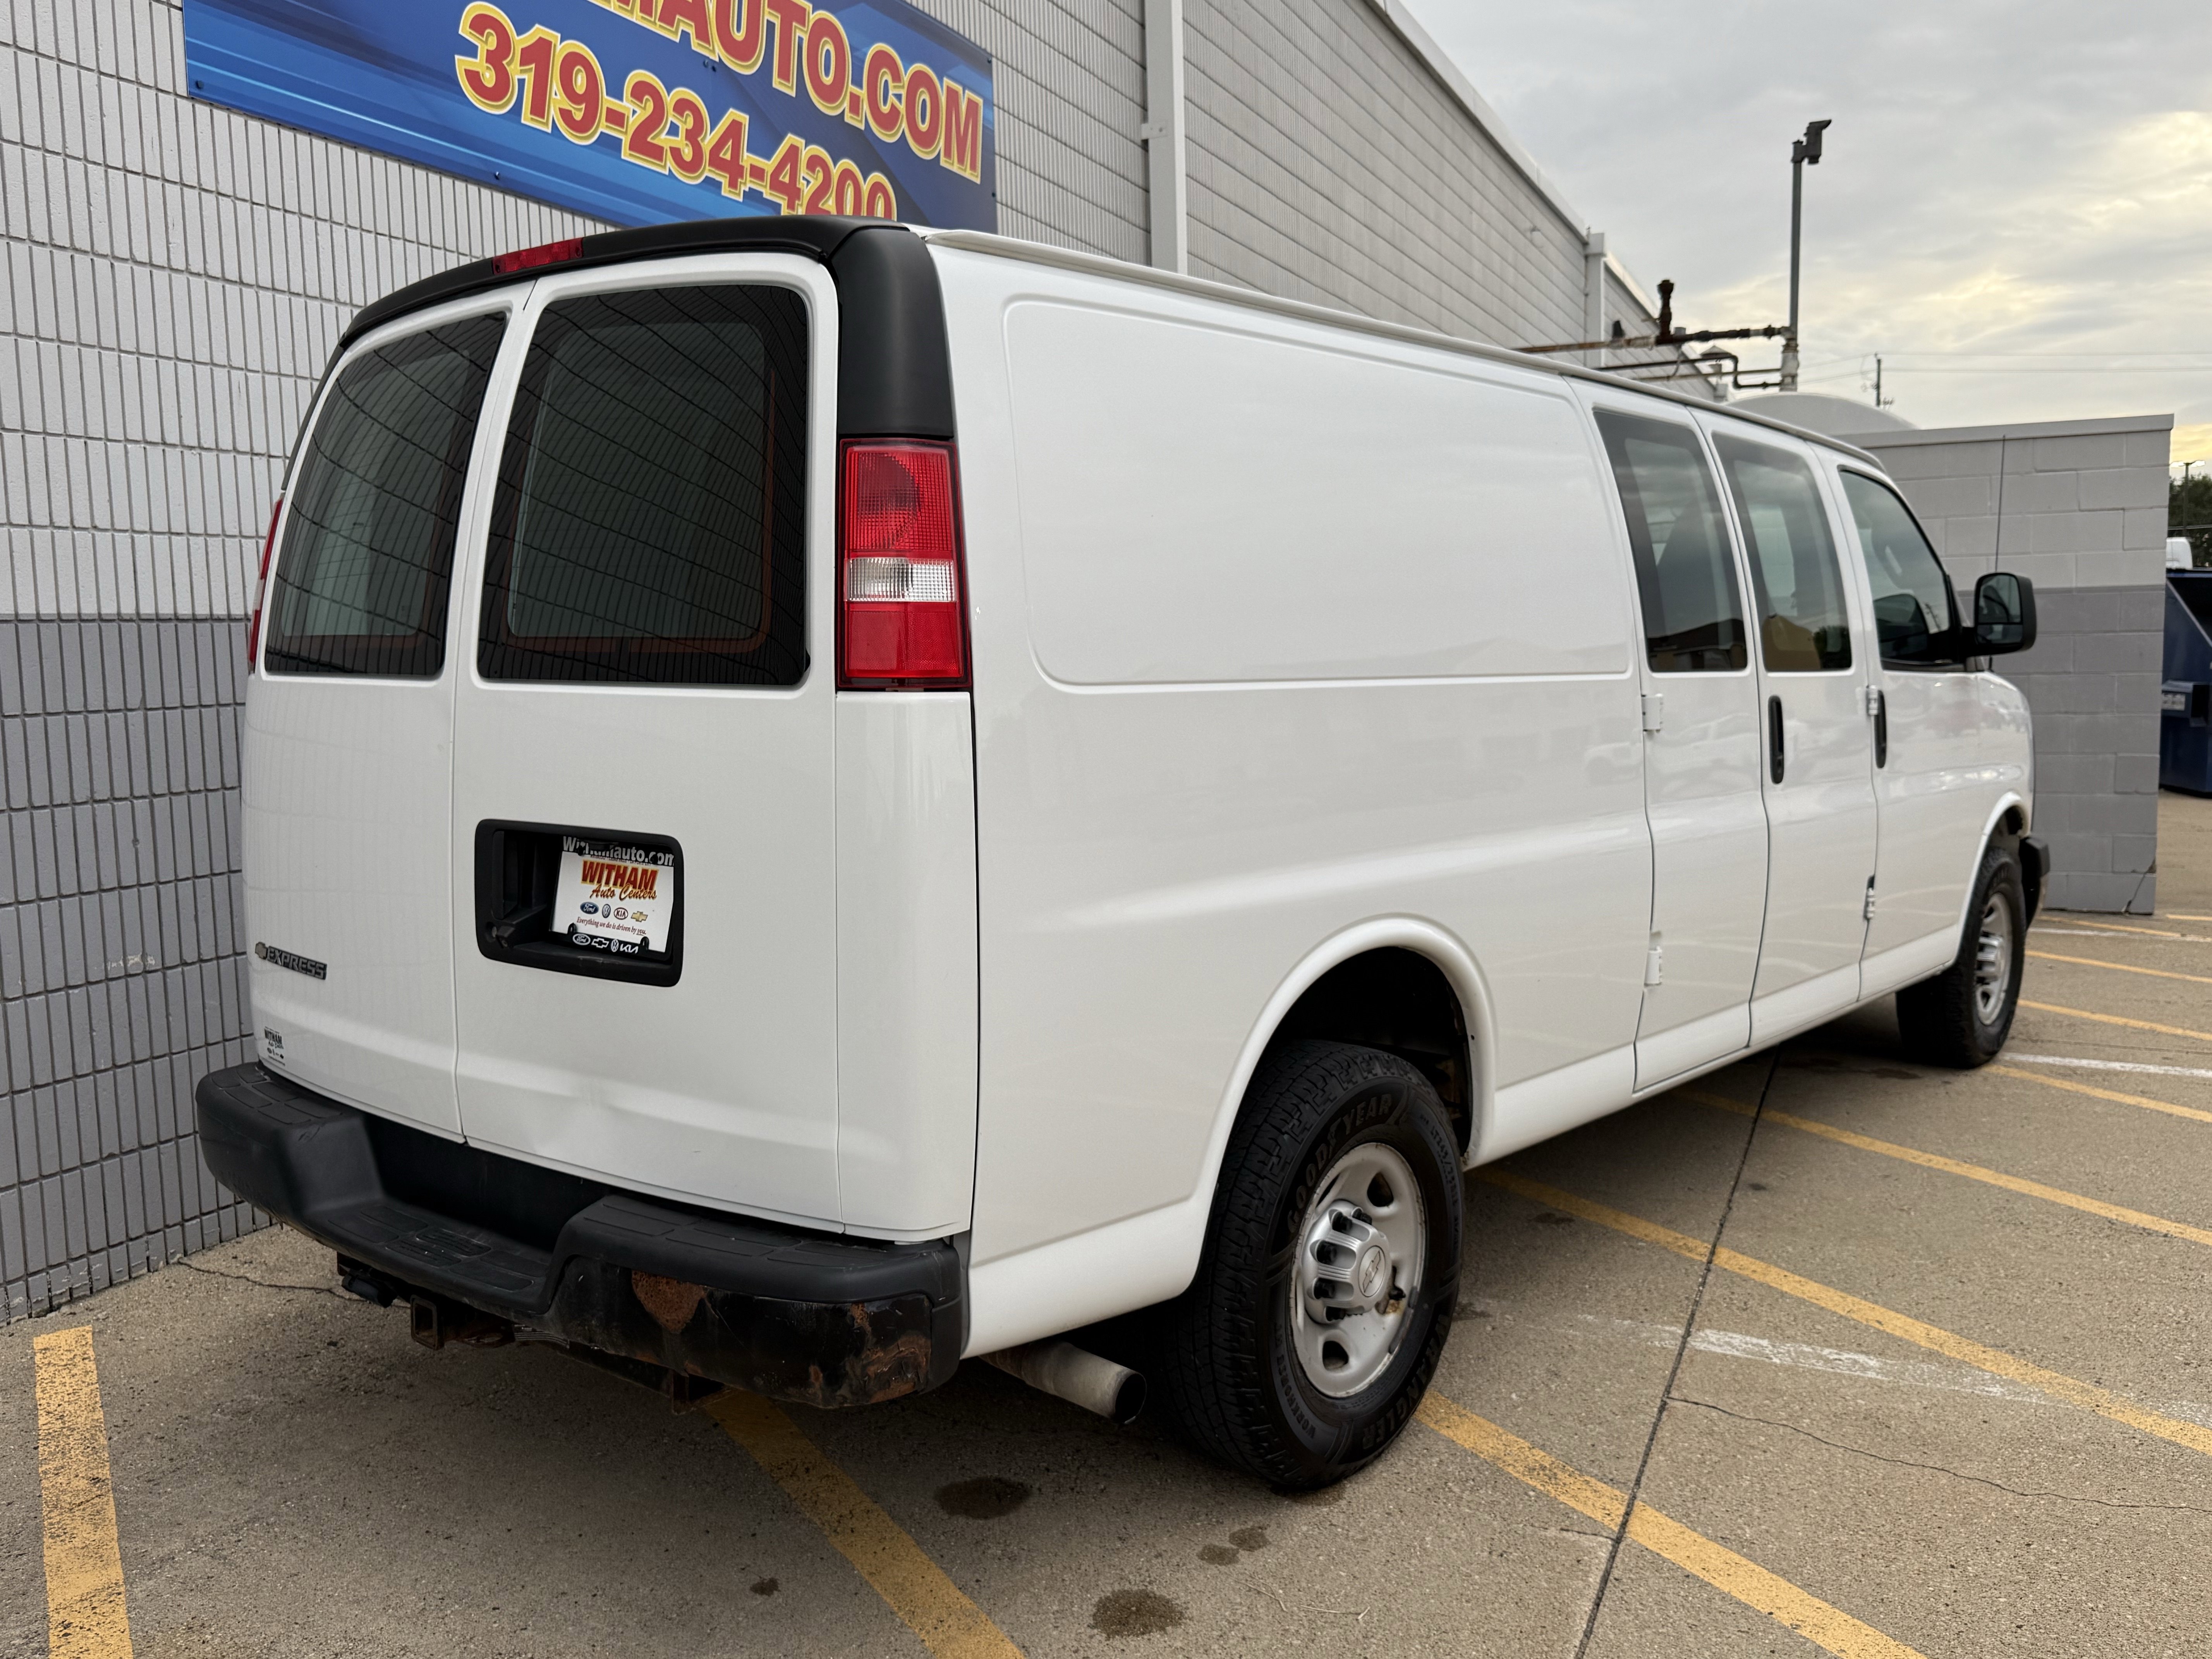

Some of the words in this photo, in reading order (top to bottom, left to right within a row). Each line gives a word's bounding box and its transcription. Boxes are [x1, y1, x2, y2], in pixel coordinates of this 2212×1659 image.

[455, 1, 897, 219] 319-234-4200
[613, 0, 982, 184] AUTO.COM
[582, 860, 659, 891] WITHAM
[590, 884, 616, 898] Auto
[619, 883, 657, 901] Centers
[267, 947, 325, 980] EXPRESS
[577, 917, 599, 928] Everything
[617, 924, 630, 932] driven
[631, 926, 637, 934] by
[1287, 1094, 1392, 1233] GOODYEAR
[1276, 1354, 1317, 1439] WORKHORSE
[1362, 1314, 1451, 1450] WRANGLER
